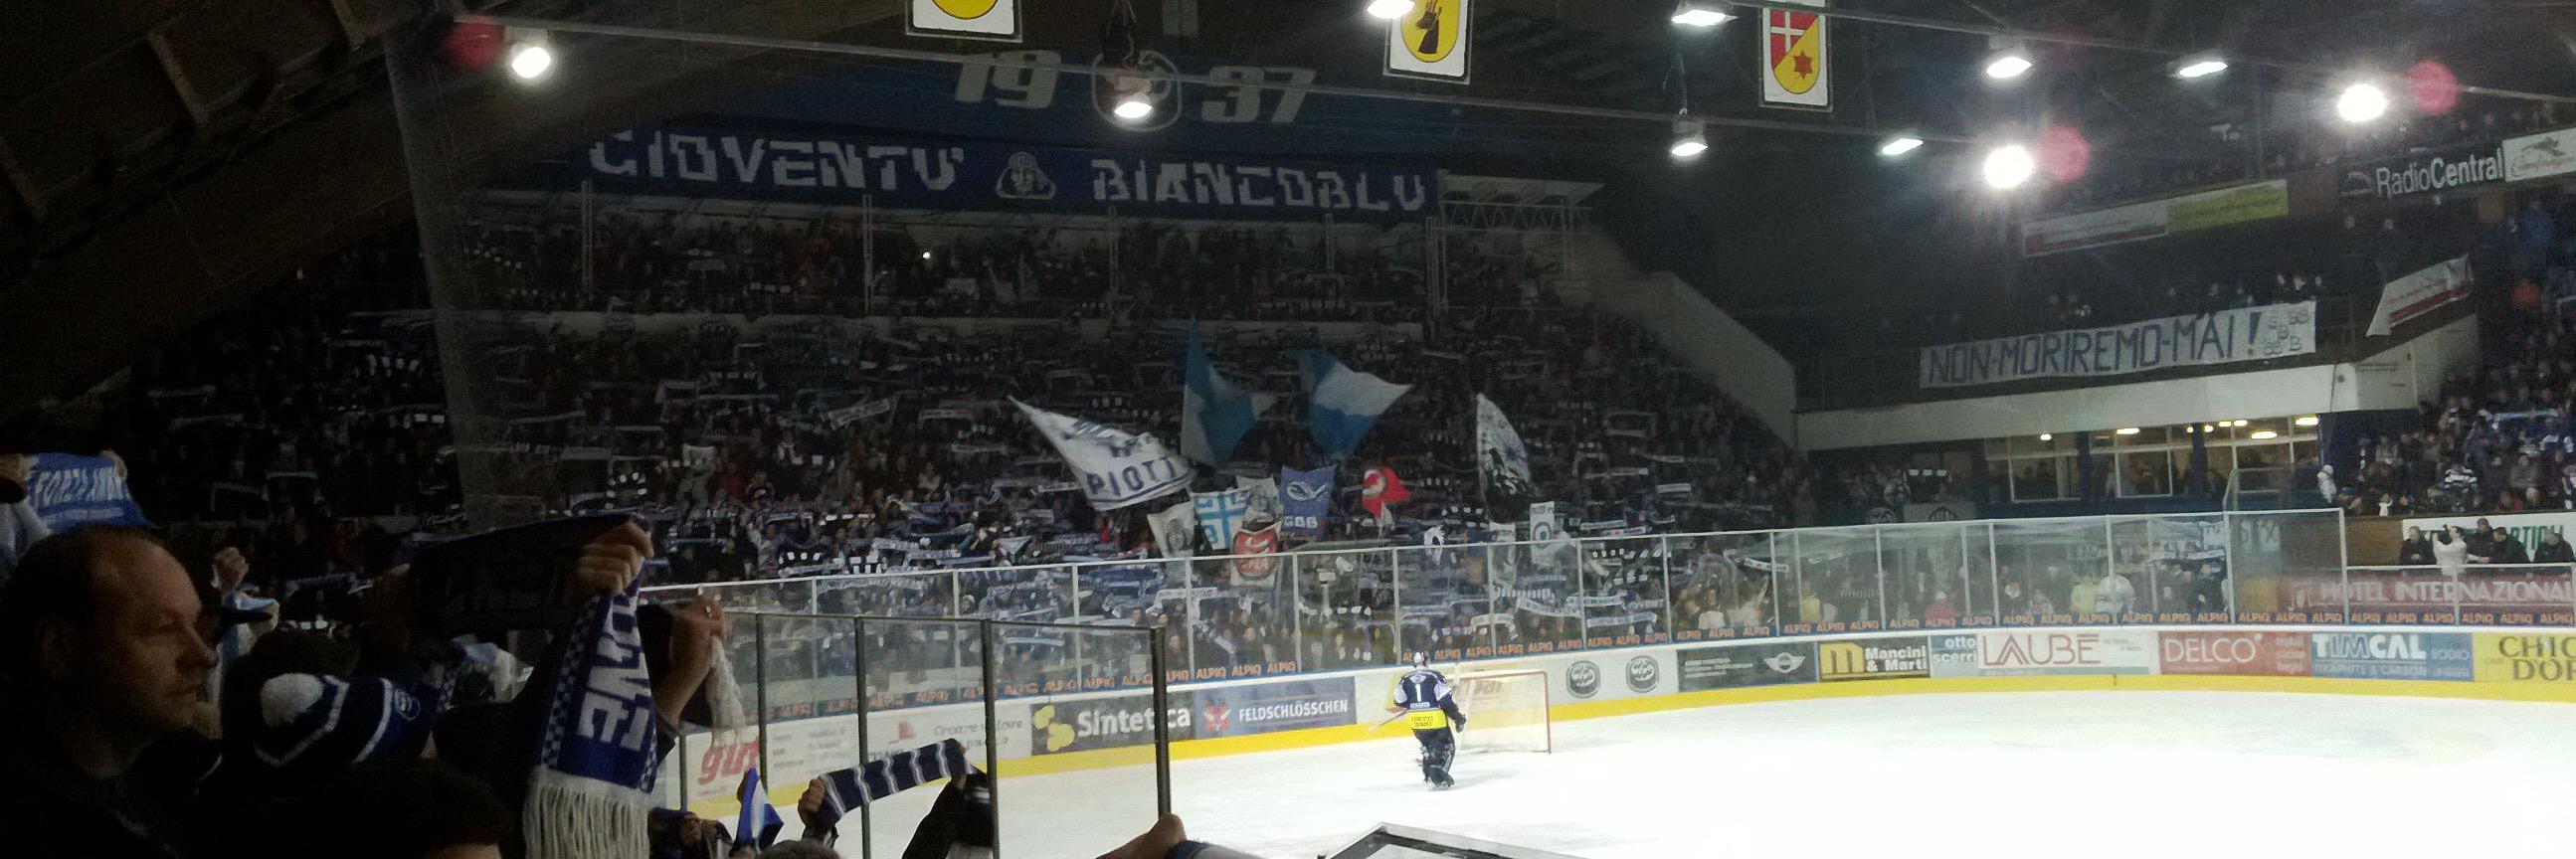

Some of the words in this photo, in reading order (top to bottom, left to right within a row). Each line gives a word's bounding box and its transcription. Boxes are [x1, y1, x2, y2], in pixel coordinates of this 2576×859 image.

[954, 51, 1062, 109] 19
[1201, 67, 1316, 123] 37
[1865, 644, 1927, 660] Mancini
[2163, 637, 2256, 663] DELCO
[2312, 633, 2427, 659] TIMCAL
[1166, 669, 1191, 682] LPIQ
[1885, 656, 1928, 672] Marti
[1415, 683, 1422, 703] 1
[1077, 707, 1192, 739] Sintetca
[1239, 699, 1349, 723] FELDSCHLÖSSCHEN
